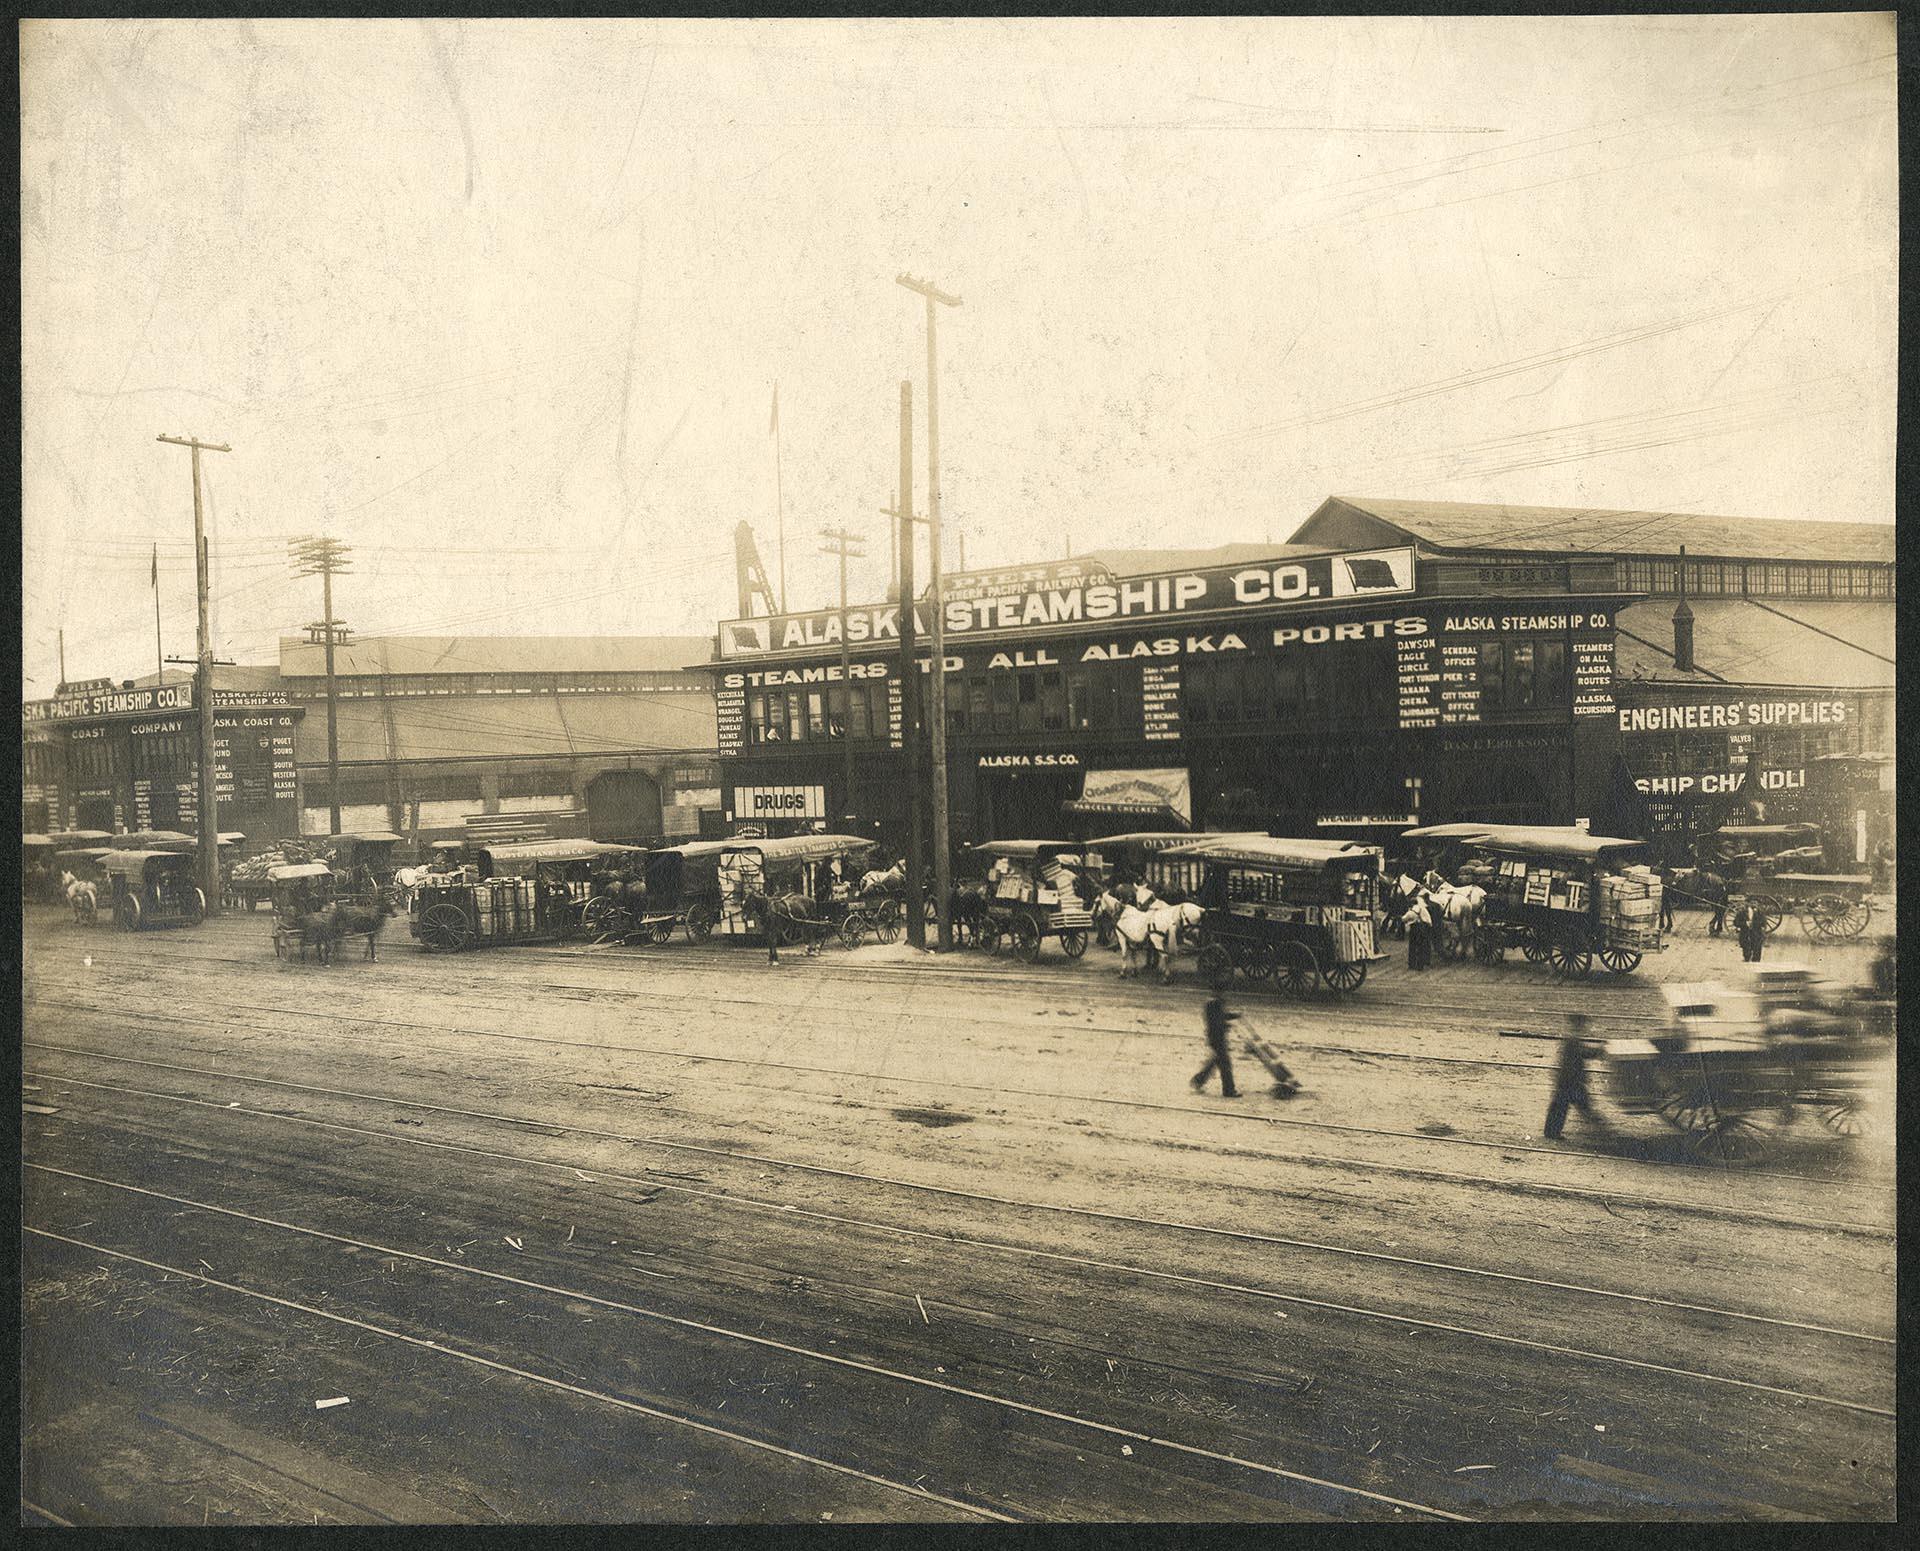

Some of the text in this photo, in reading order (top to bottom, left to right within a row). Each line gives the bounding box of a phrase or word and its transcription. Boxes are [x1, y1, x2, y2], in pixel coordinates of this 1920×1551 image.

[952, 565, 1081, 589] PIER 2
[988, 583, 1028, 597] PACIFIC
[1036, 576, 1085, 592] RAILWAY
[1090, 574, 1108, 586] CO.
[946, 575, 1207, 632] STEAMSHIP
[1234, 565, 1320, 604] CO.
[1444, 614, 1610, 631] ALASKA STEAMSHIP CO.
[1397, 639, 1435, 650] DAWSON
[1573, 643, 1613, 653] STEAMERS
[724, 662, 888, 688] STEAMERS
[988, 650, 1058, 669] ALL
[1080, 633, 1247, 662] ALASKA
[1273, 616, 1428, 647] PORTS
[1442, 646, 1478, 655] GENERAL
[1398, 652, 1425, 662] EAGLE
[1444, 658, 1476, 666] OFFICES
[1592, 655, 1608, 663] ALL
[1398, 663, 1429, 673] CIRCLE
[1576, 665, 1612, 675] ALASKA
[1443, 672, 1463, 682] PIER
[1578, 677, 1610, 686] ROUTES
[50, 699, 89, 718] PACIFIC
[93, 691, 152, 714] STEAMSHIP
[157, 689, 178, 708] CO.
[272, 697, 288, 705] CO.
[1575, 694, 1613, 703] ALASKA
[1573, 705, 1616, 715] EXCURSIONS
[1619, 700, 1846, 732] ENGINEERS' SUPPLIES
[213, 717, 293, 728] ASKA COAST CO.
[72, 728, 106, 739] COAST
[131, 721, 183, 735] COMPANY
[272, 737, 291, 746] PUGET
[1730, 734, 1751, 743] VALVES
[274, 761, 293, 769] SOUTH
[979, 756, 1030, 767] ALASKA
[273, 781, 296, 789] ALASKA
[1635, 776, 1694, 795] SHIP
[275, 791, 295, 799] ROUTE
[755, 794, 804, 810] DRUGS
